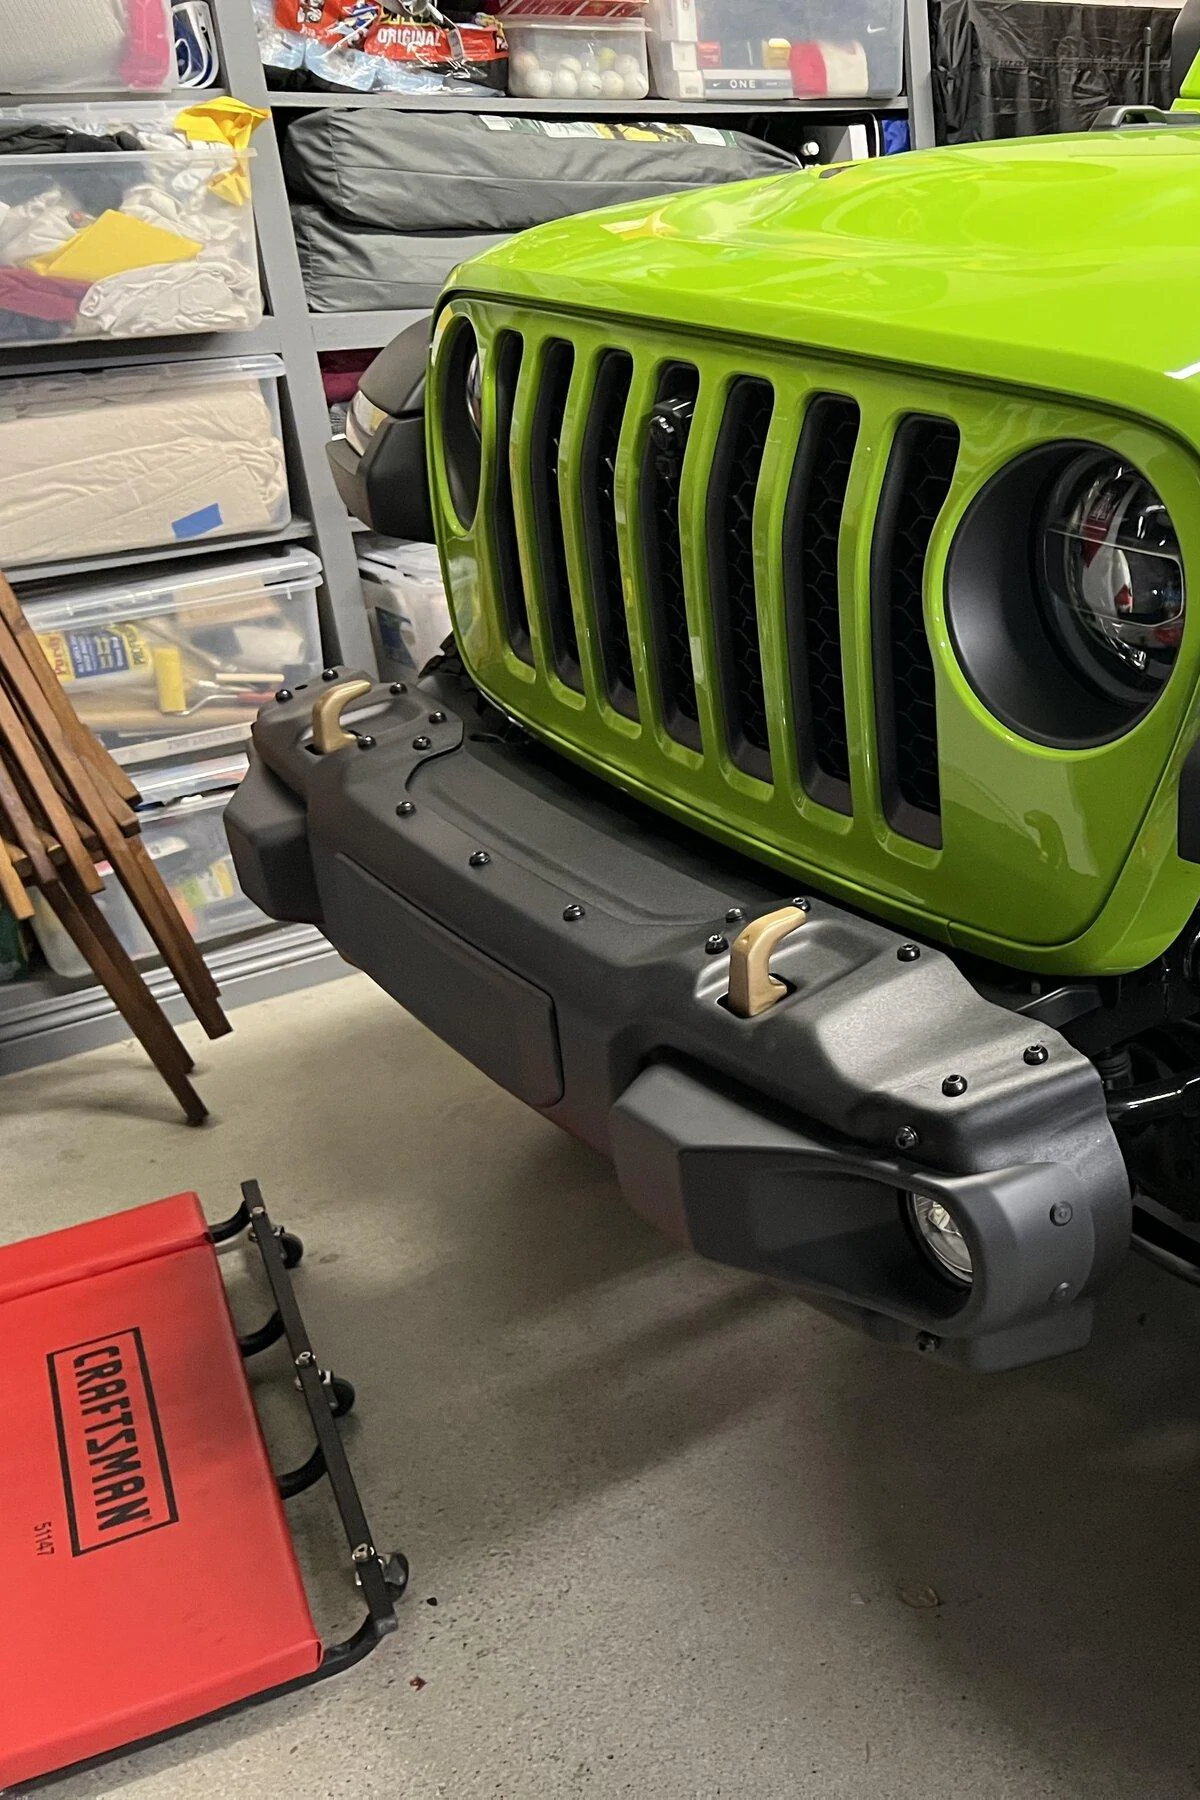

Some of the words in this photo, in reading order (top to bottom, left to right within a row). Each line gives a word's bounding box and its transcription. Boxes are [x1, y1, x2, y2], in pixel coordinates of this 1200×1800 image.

[377, 28, 441, 46] ORIGINAL
[729, 79, 757, 89] ONE
[73, 1344, 151, 1531] CRAFTSMAN
[34, 1521, 55, 1556] 51147
